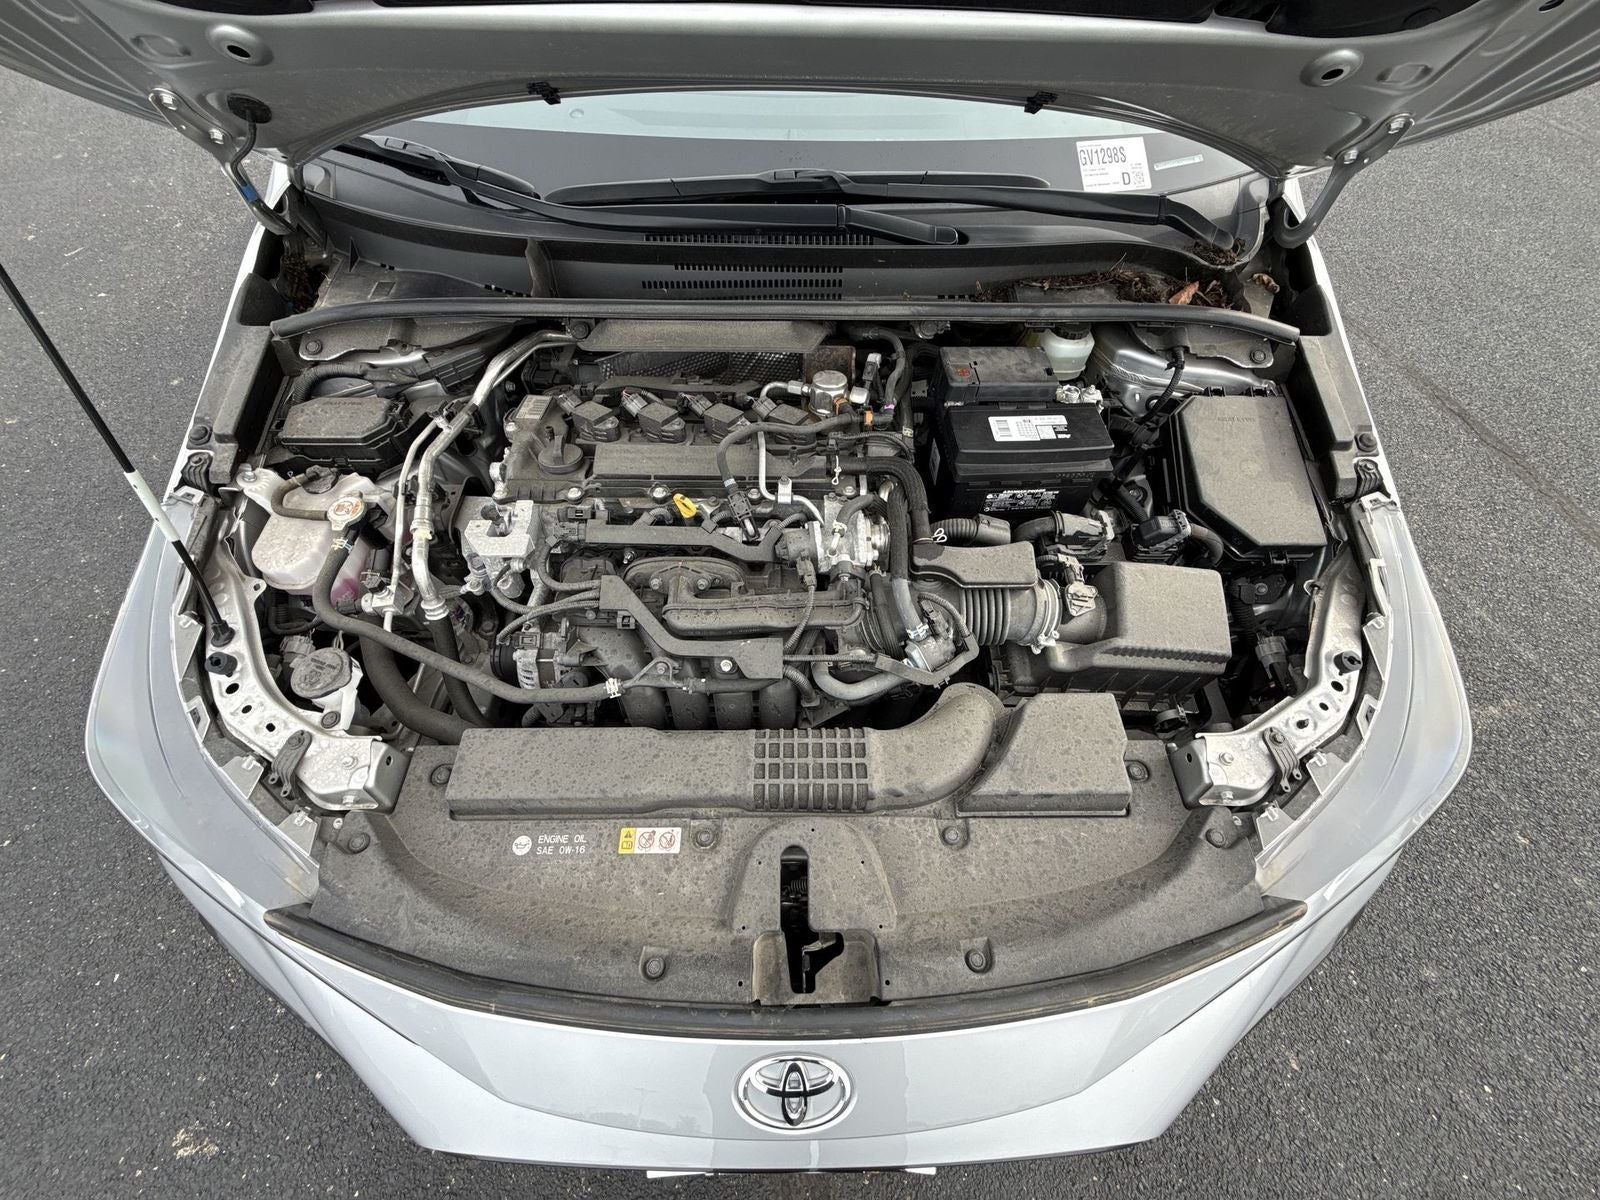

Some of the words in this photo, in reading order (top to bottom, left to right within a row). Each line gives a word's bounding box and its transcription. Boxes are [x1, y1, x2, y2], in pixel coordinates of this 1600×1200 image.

[1079, 146, 1127, 166] GV1298S
[1122, 172, 1131, 185] D
[537, 834, 569, 844] ENGINE
[574, 834, 587, 843] OIL
[536, 846, 554, 855] SAE
[559, 845, 586, 855] 0W-16
